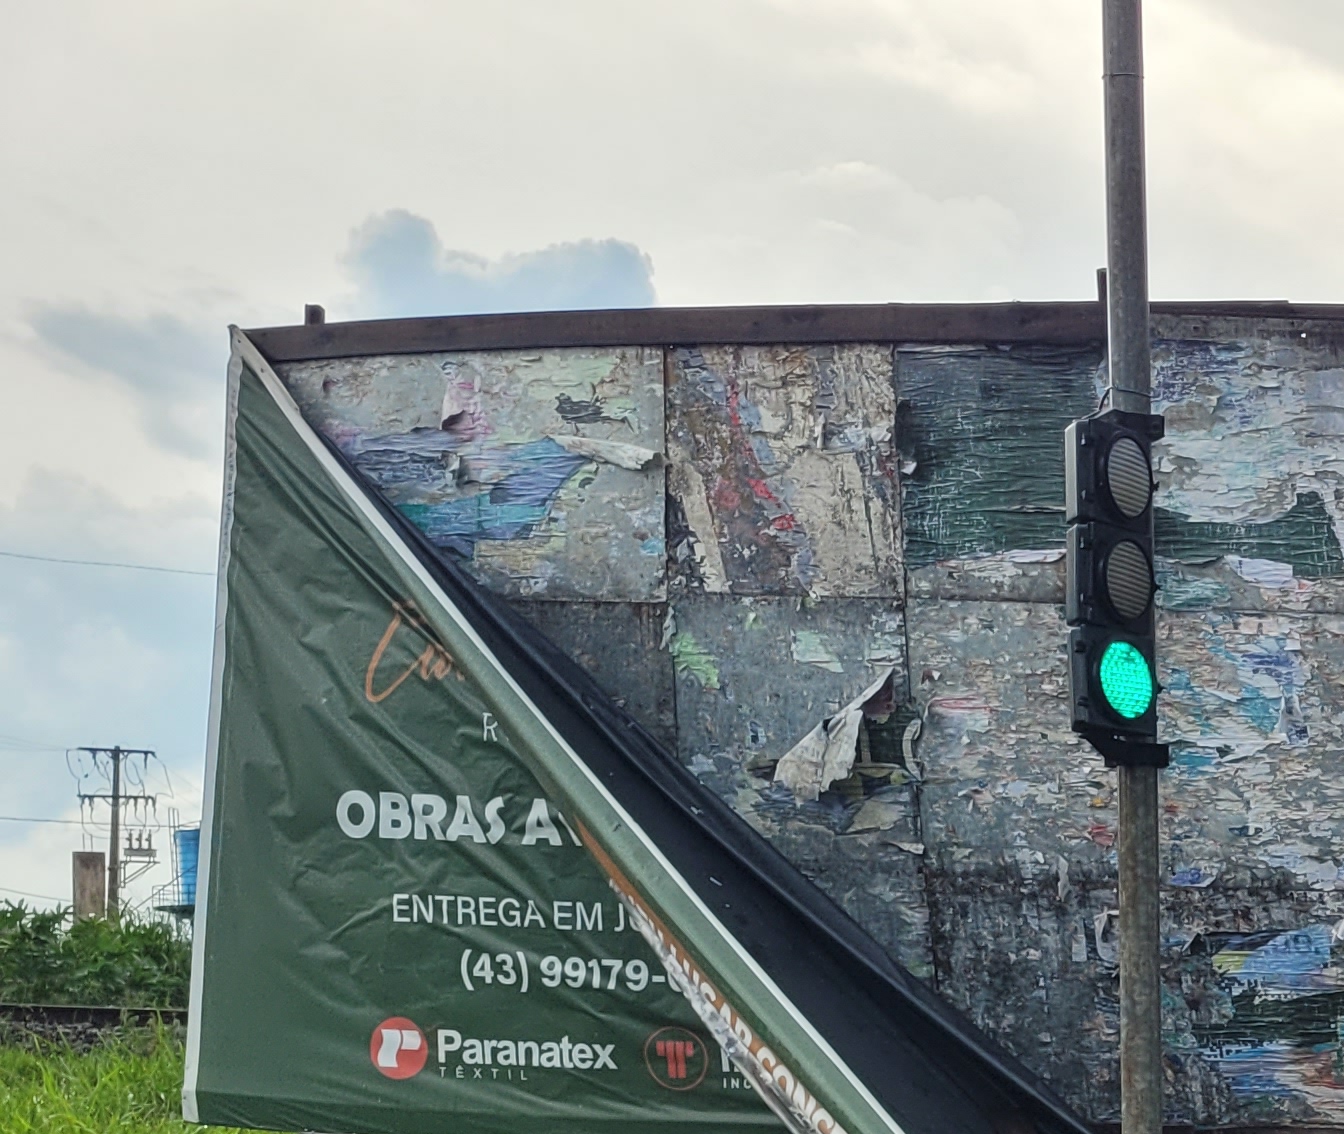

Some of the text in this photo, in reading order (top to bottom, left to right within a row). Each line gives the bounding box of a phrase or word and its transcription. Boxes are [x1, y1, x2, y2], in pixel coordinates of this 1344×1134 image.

[336, 790, 506, 845] OBRAS
[392, 894, 547, 929] ENTREGA
[553, 901, 603, 932] EM
[459, 949, 529, 992] (43)
[436, 1029, 619, 1072] Paranatex
[438, 1065, 529, 1083] TÊXTIL
